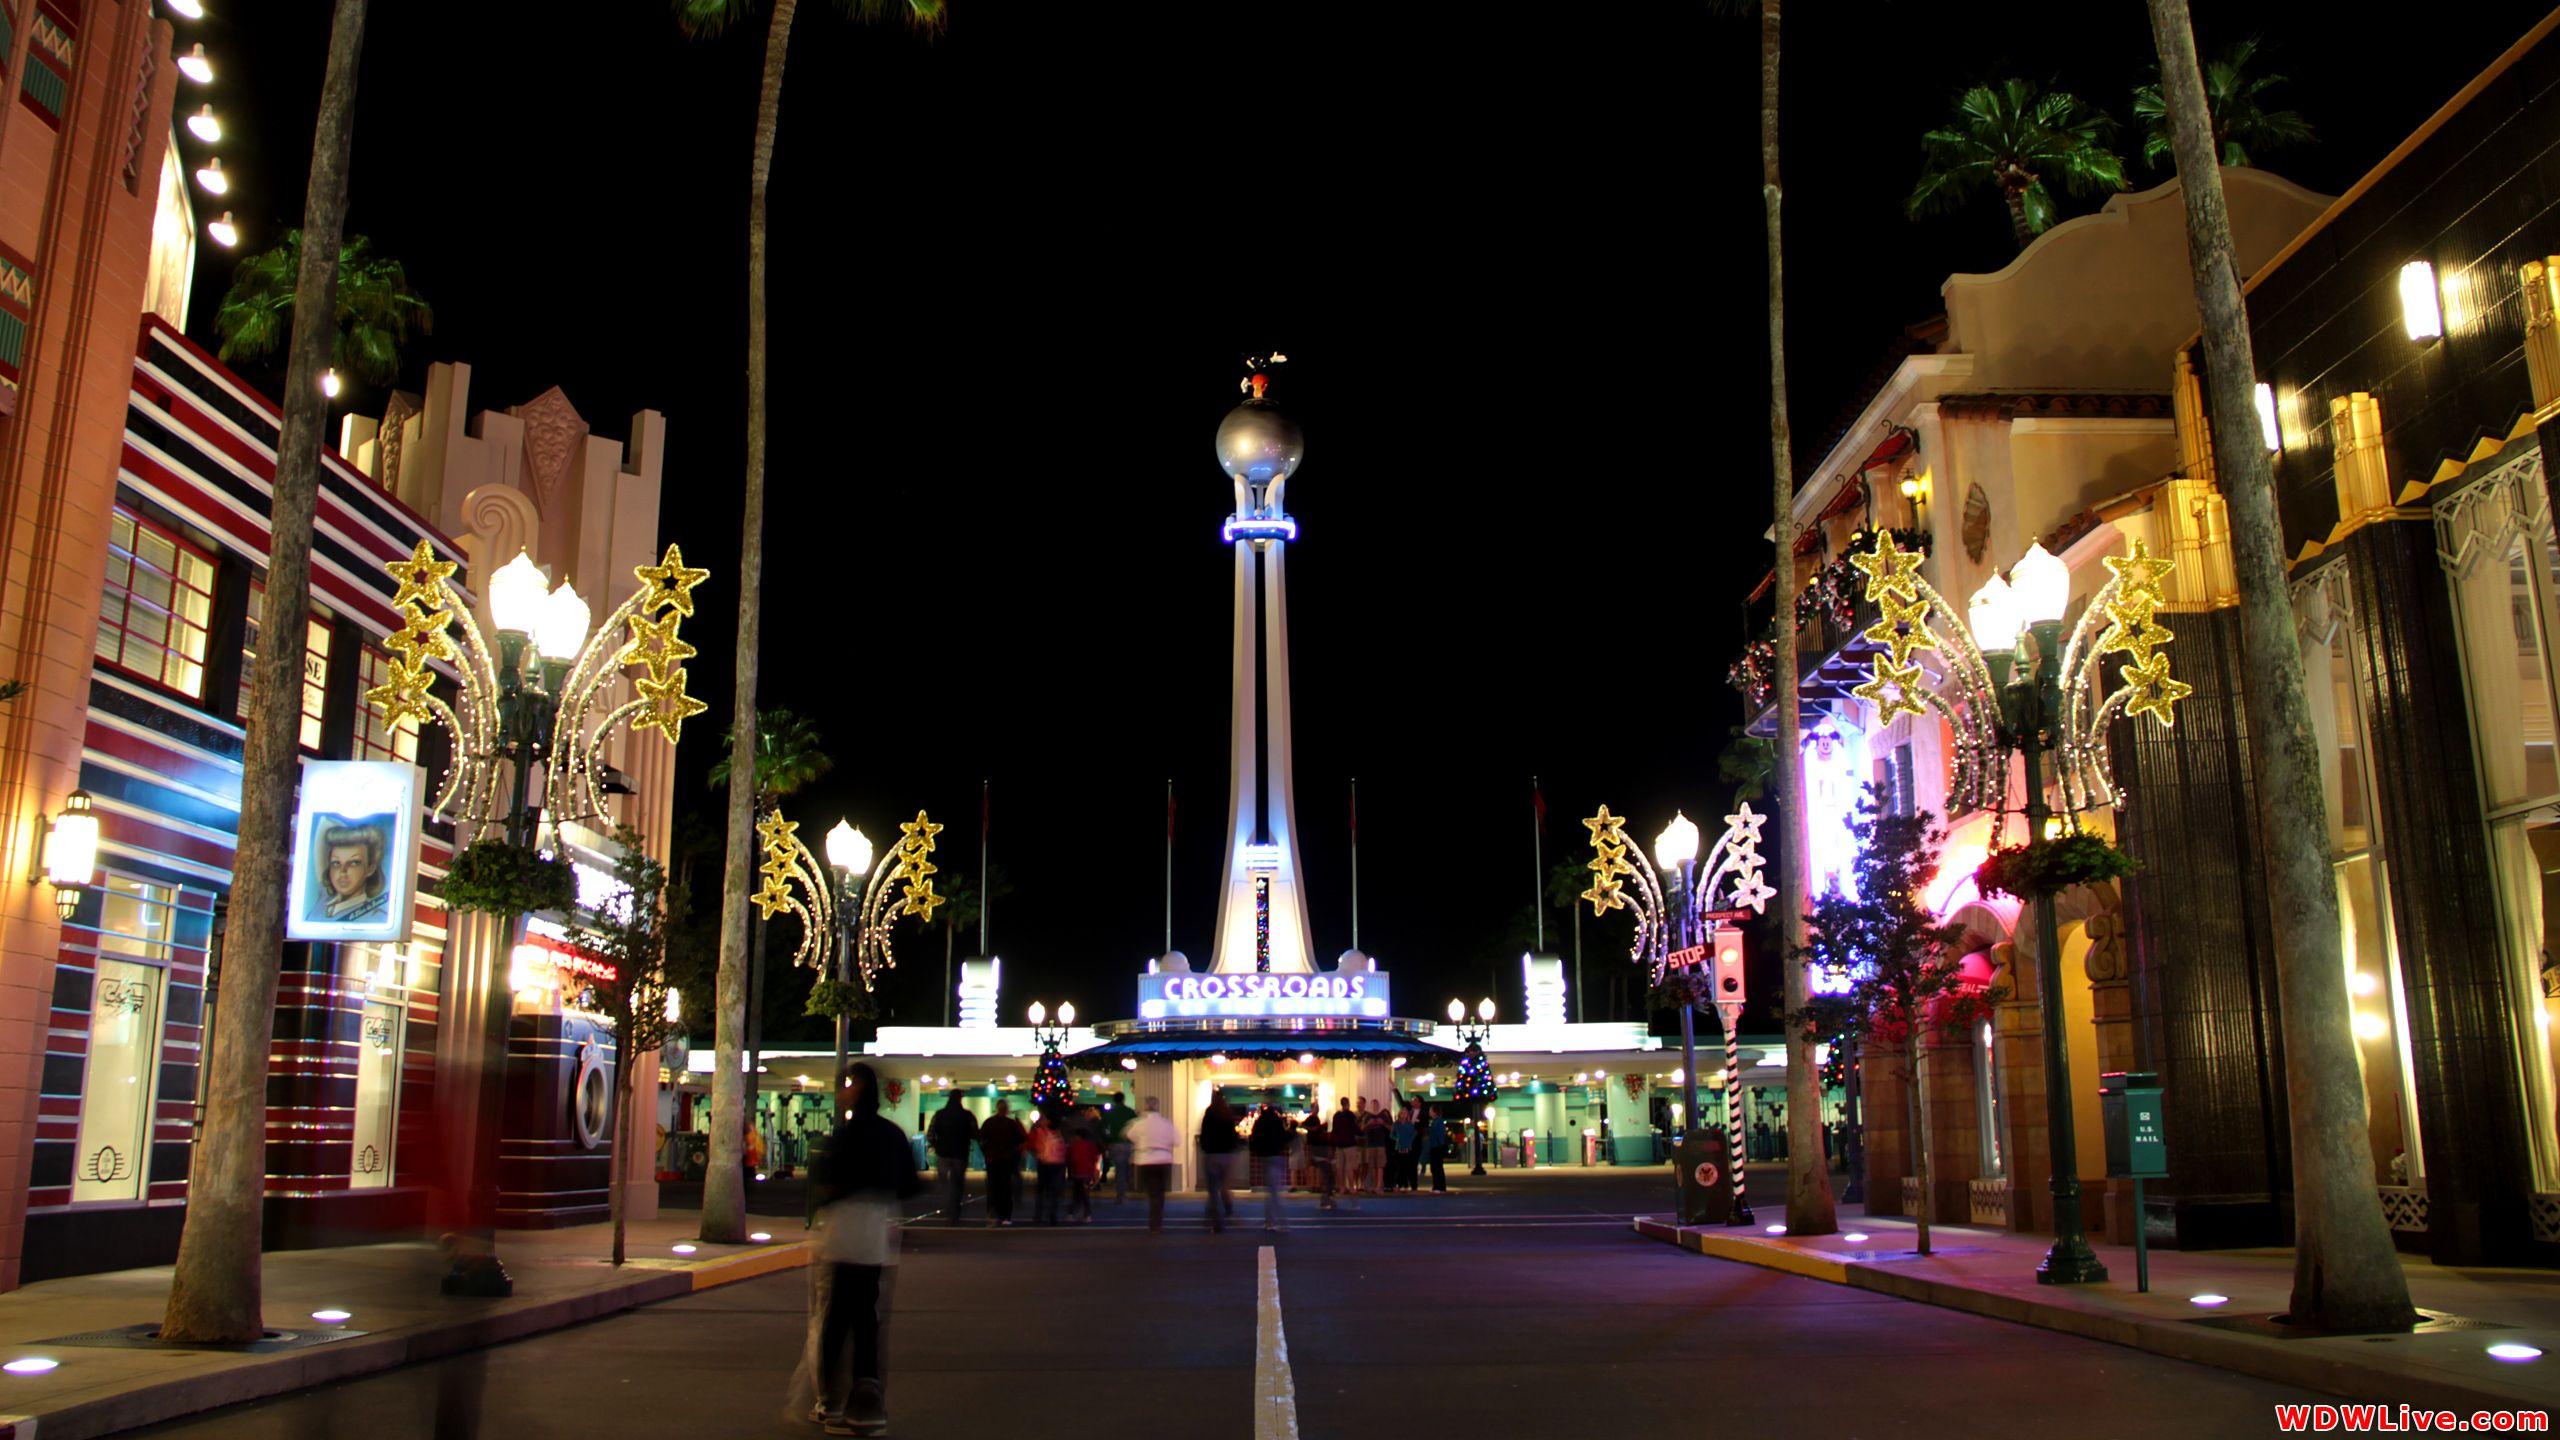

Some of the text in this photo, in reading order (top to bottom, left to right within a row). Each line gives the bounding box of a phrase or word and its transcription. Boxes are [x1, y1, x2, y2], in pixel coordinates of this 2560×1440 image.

[1667, 944, 1705, 970] STOP
[1164, 975, 1365, 999] CROSSROADS
[2135, 1135, 2159, 1143] MAIL
